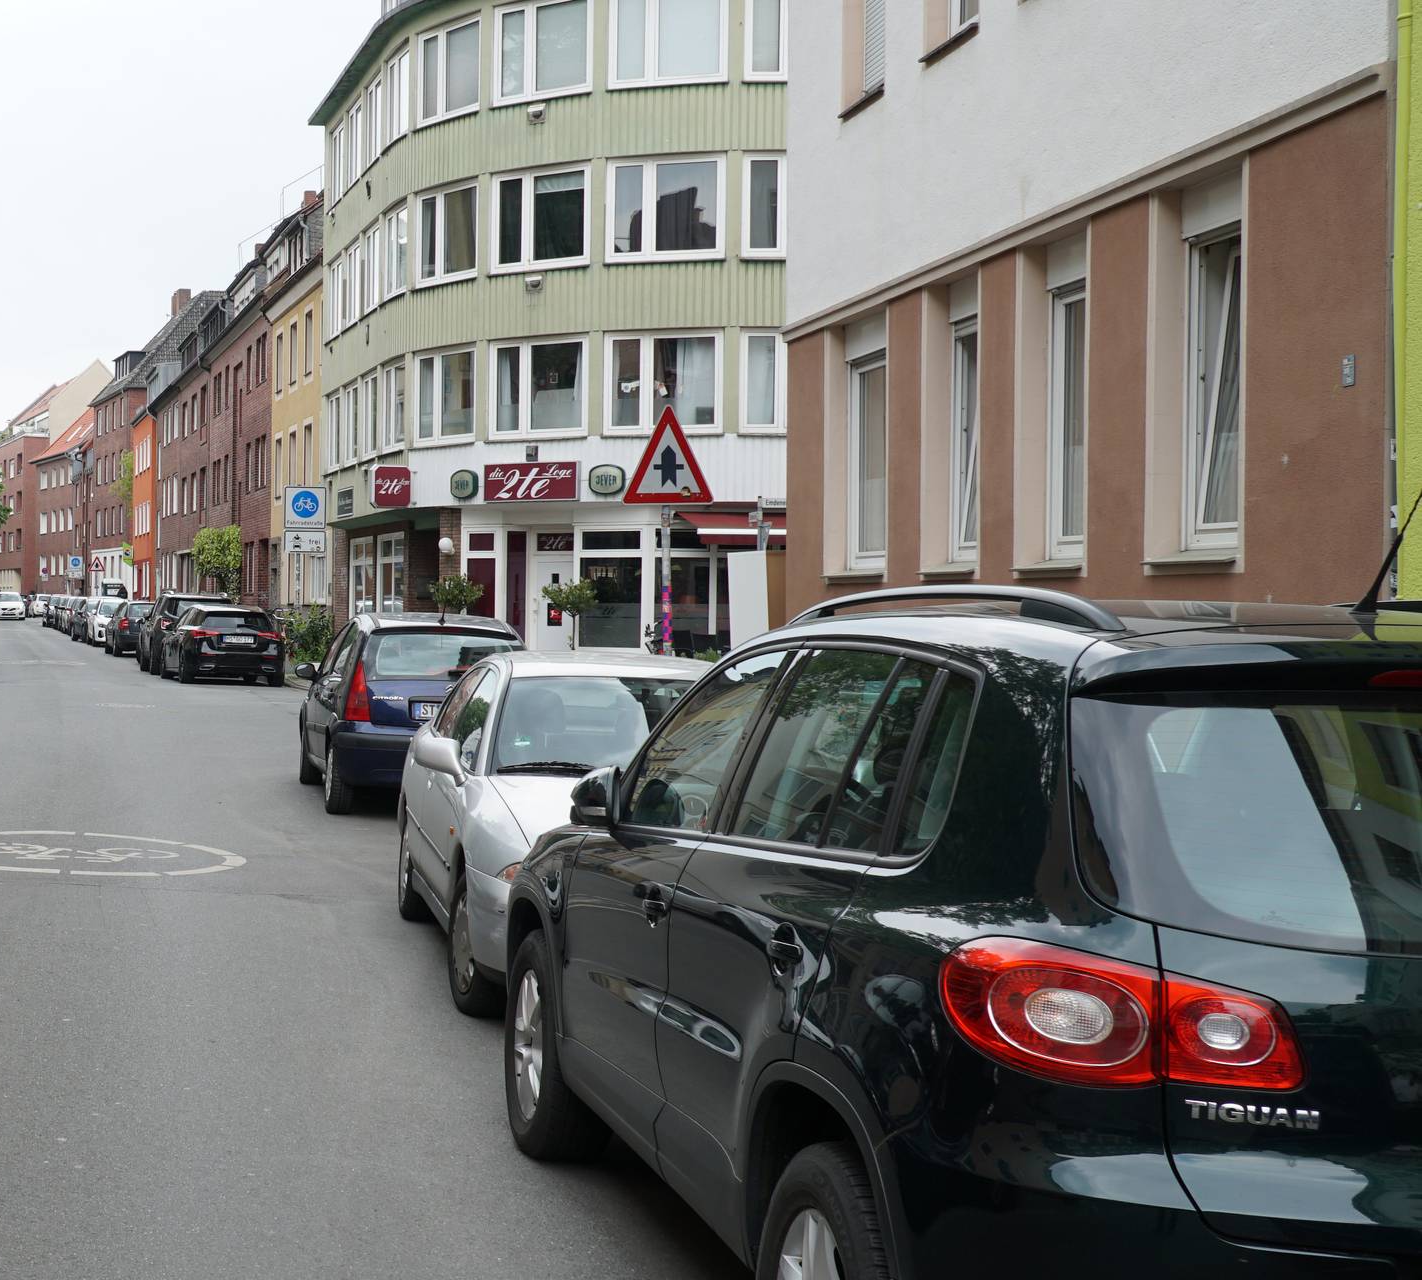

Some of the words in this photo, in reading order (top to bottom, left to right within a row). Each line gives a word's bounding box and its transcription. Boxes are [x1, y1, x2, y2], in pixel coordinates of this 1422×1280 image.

[489, 468, 505, 478] die
[542, 464, 572, 479] Loge
[422, 704, 435, 716] ST
[1185, 1098, 1321, 1130] TIGUAN
